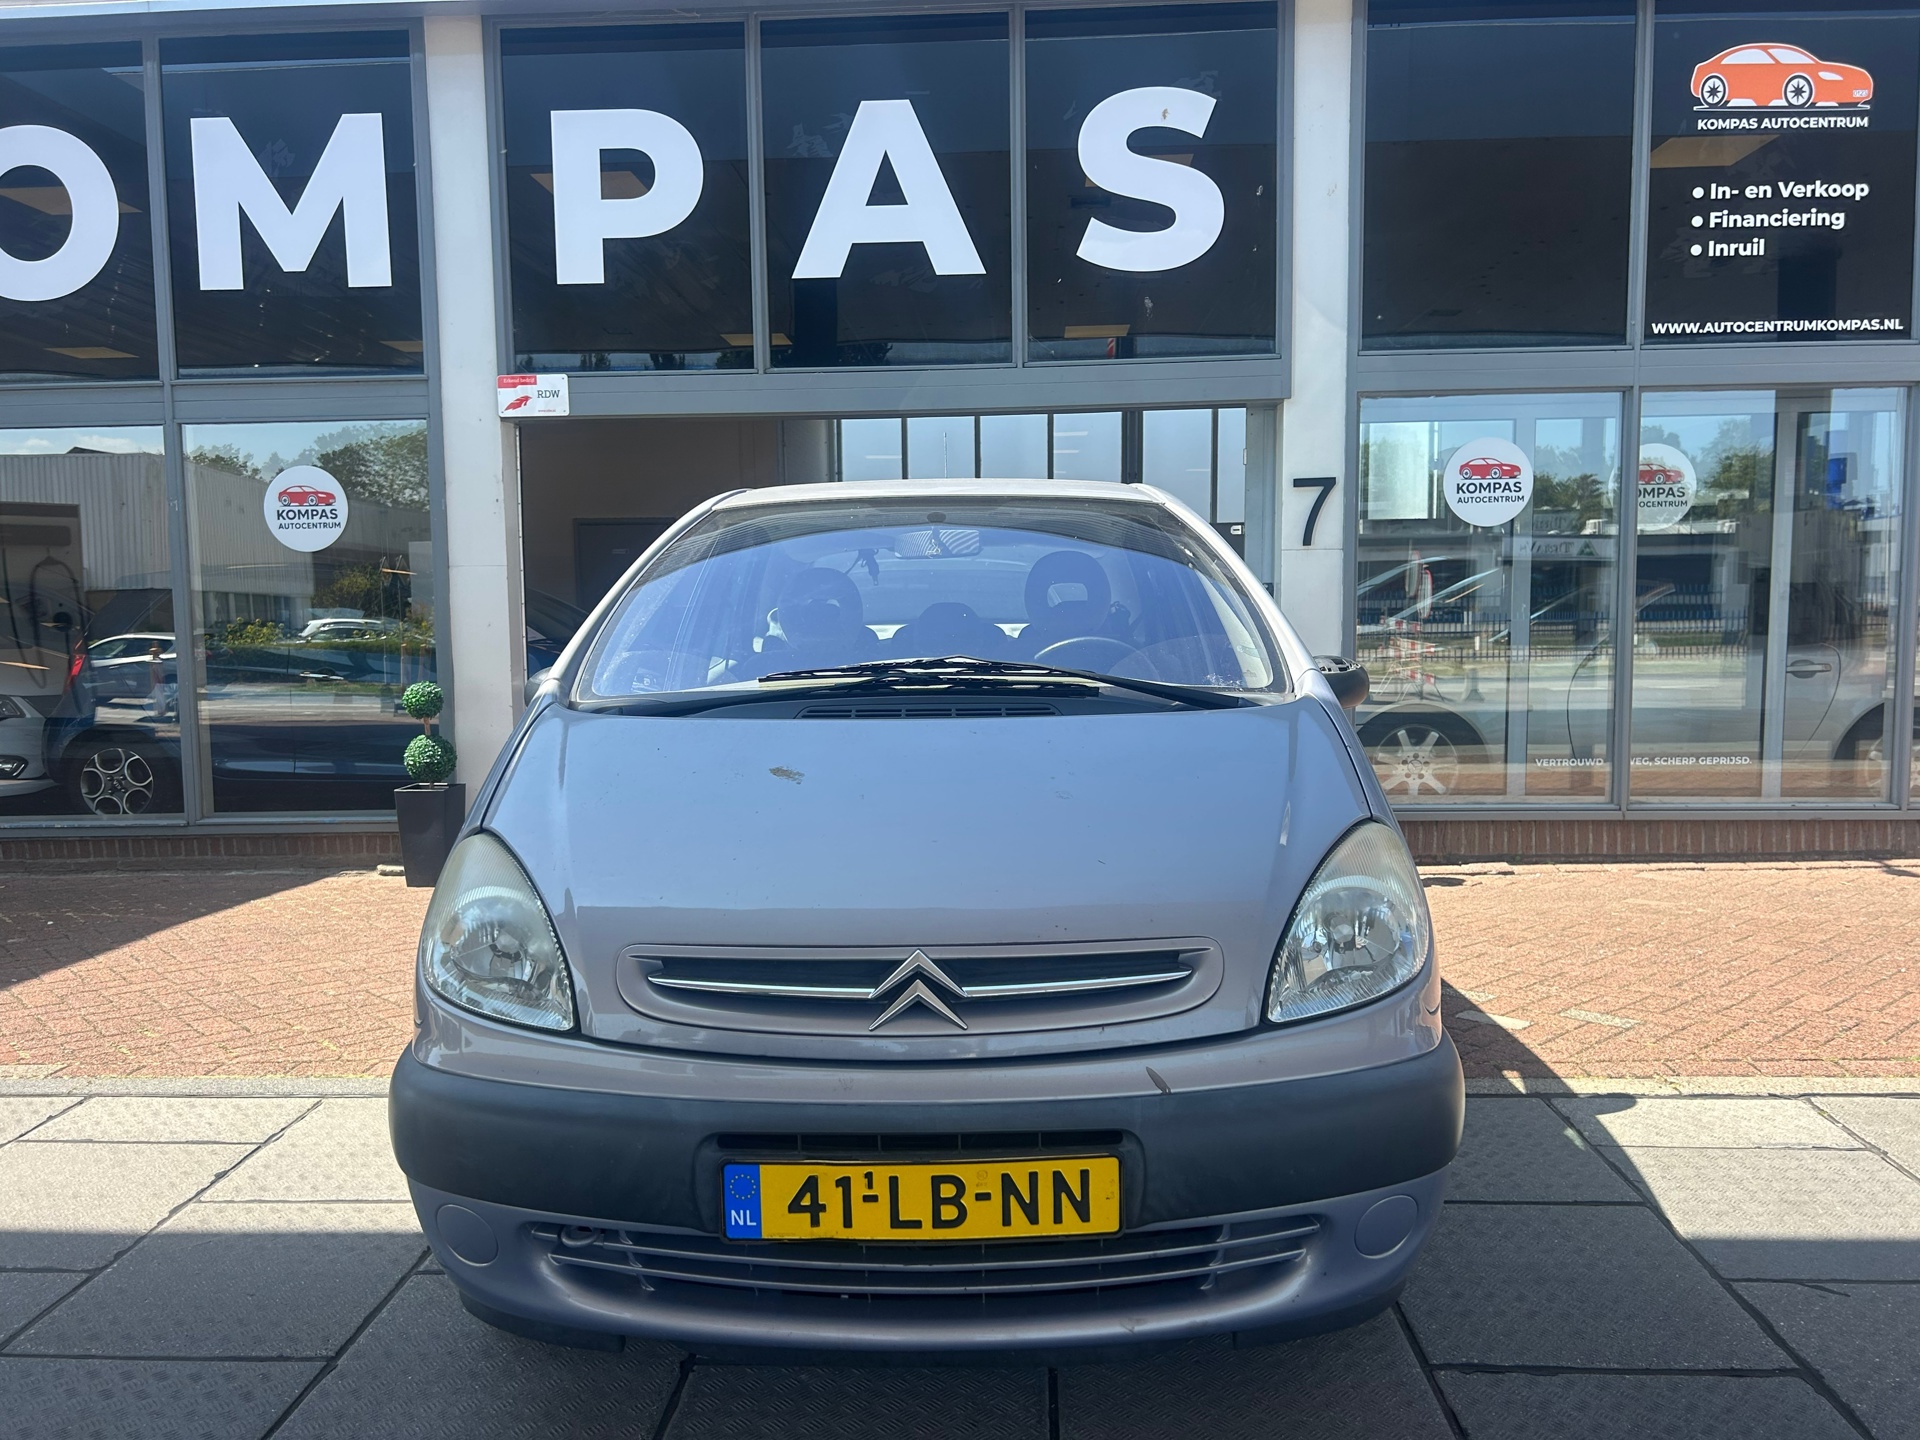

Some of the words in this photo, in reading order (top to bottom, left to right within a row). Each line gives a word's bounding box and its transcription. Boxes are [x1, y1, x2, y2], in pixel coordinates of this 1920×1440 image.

[1697, 118, 1758, 130] KOMPAS
[1761, 116, 1869, 129] AUTOCENTRUM
[1711, 183, 1739, 199] In-
[1745, 186, 1772, 199] en
[1778, 180, 1870, 201] Verkoop
[1709, 208, 1846, 230] Financiering
[1708, 239, 1766, 257] Inruil
[1652, 319, 1904, 334] WWW.AUTOCENTRUMKOMPAS.NL
[537, 390, 560, 399] RDW
[1456, 481, 1522, 495] KOMPAS
[1638, 487, 1686, 498] MPAS
[1457, 495, 1525, 504] AUTOCENTRUM
[1639, 500, 1688, 508] OCENTRUM
[277, 508, 338, 520] KOMPAS
[1293, 477, 1337, 546] 7
[278, 522, 341, 530] AUTOCENTRUM
[1535, 758, 1604, 767] VERTROUWD
[1654, 757, 1696, 766] SCHERP
[1699, 756, 1753, 765] GEPRIJSD.
[731, 1209, 757, 1226] NL
